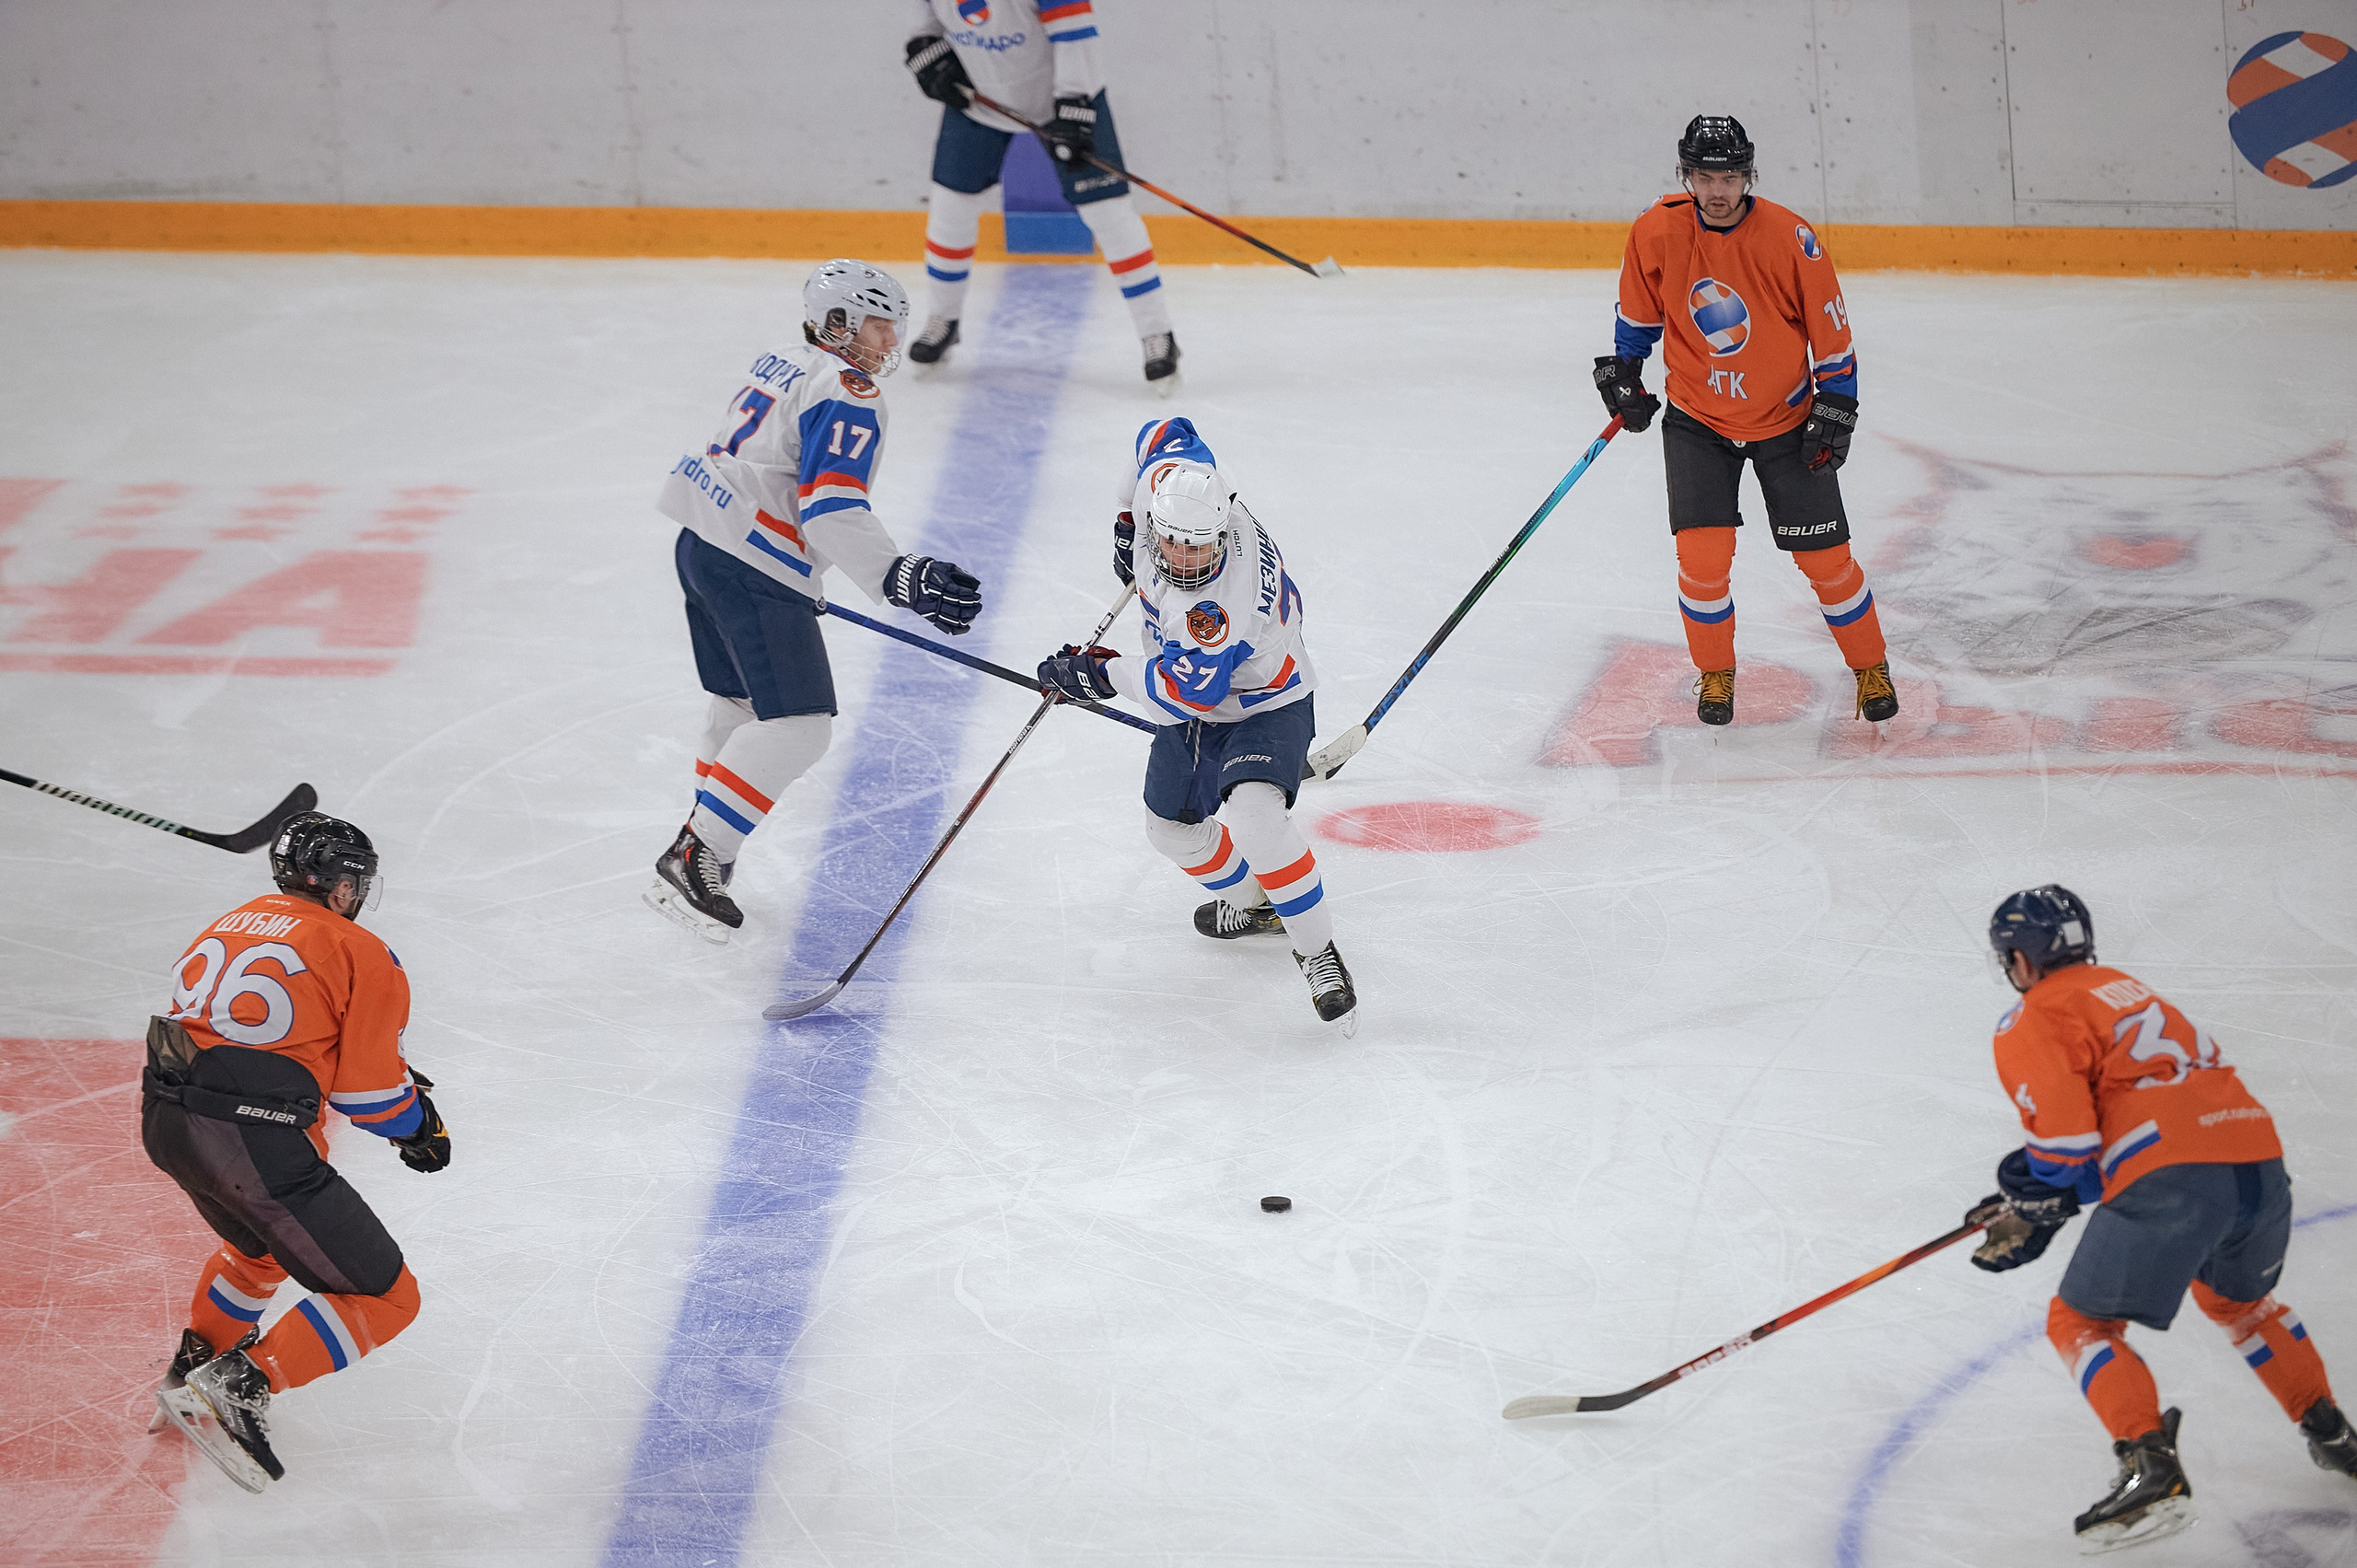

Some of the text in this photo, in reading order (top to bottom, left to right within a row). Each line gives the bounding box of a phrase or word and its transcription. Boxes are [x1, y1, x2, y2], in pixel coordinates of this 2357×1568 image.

[1823, 294, 1847, 331] 19
[828, 420, 873, 460] 17
[1167, 524, 1194, 535] BAUER
[1777, 520, 1838, 536] BAUER
[1171, 655, 1219, 691] 27
[1222, 754, 1272, 772] BAUER
[343, 860, 366, 870] CCM
[213, 912, 302, 938] ШУБИН
[171, 937, 308, 1046] 96
[235, 1104, 296, 1125] BAUER
